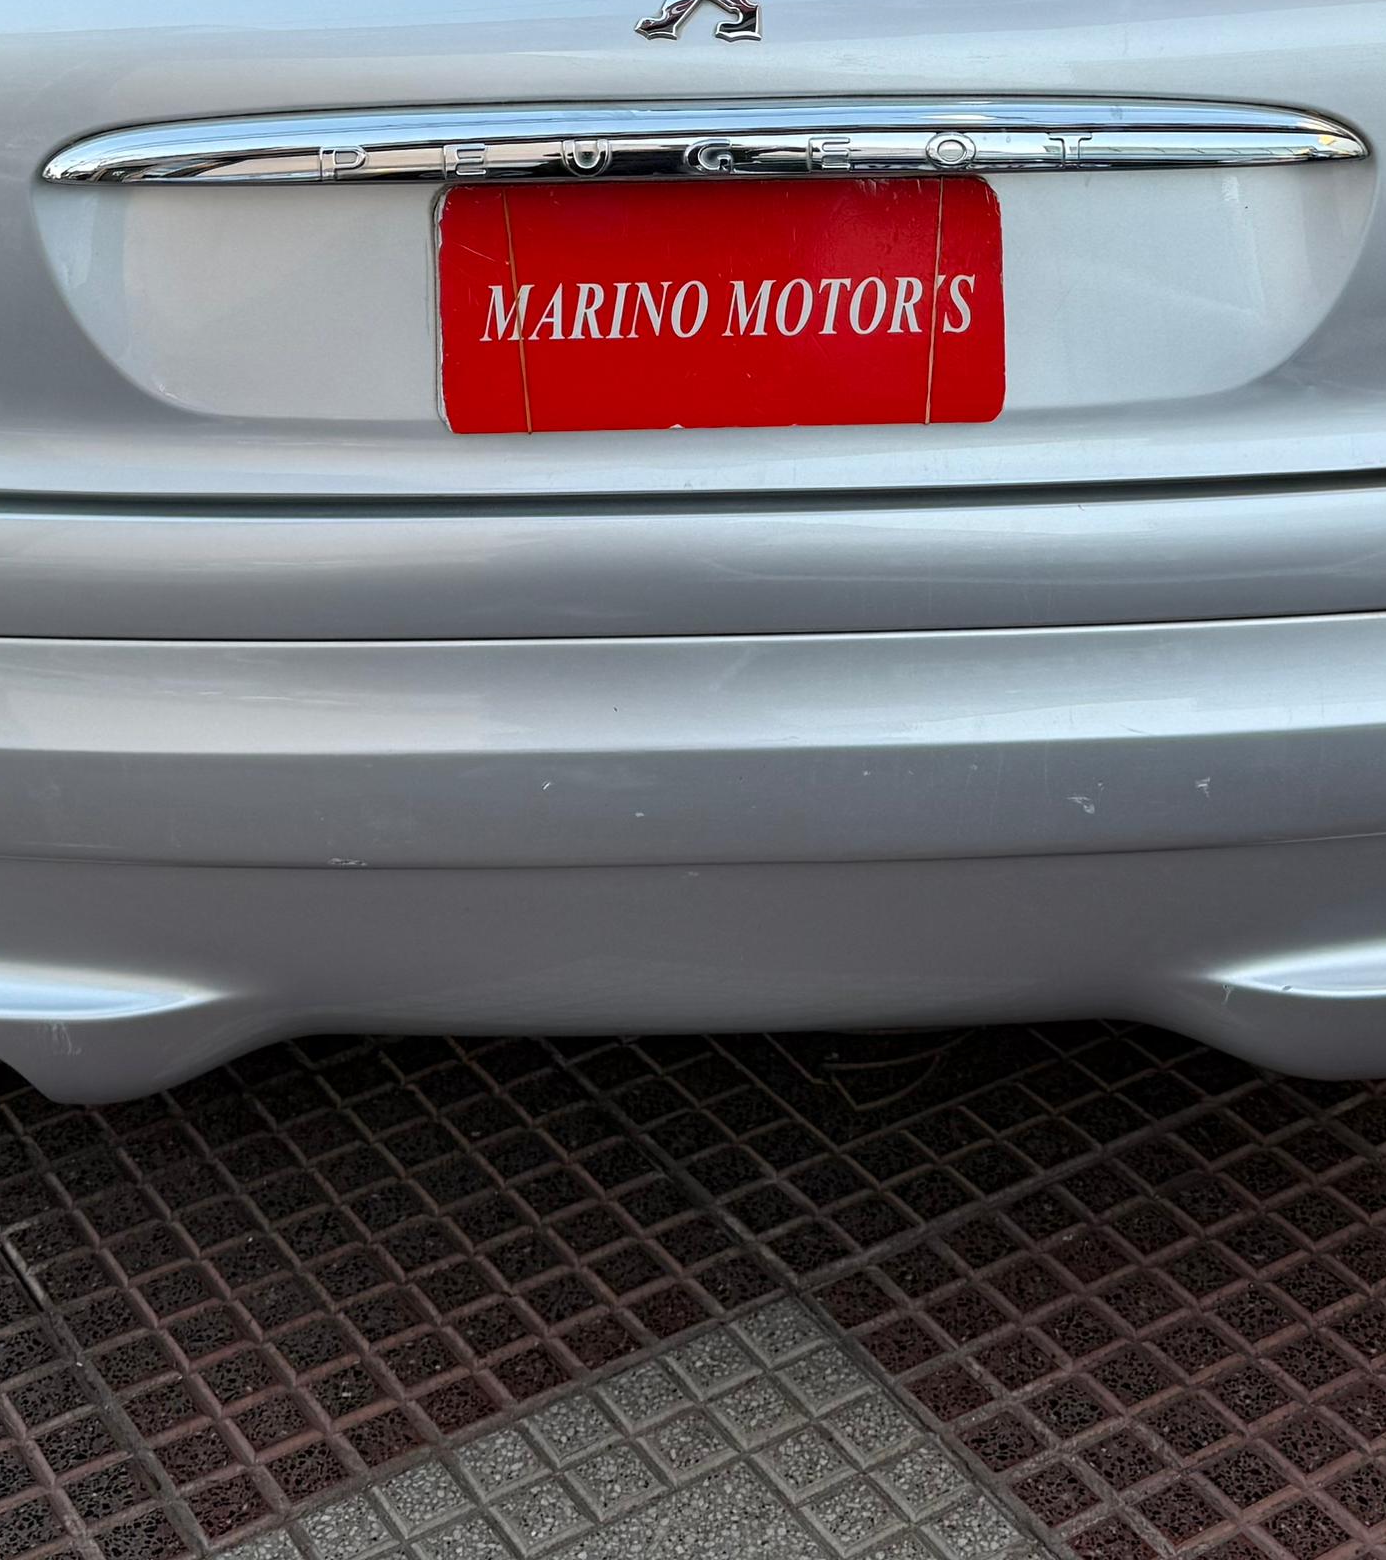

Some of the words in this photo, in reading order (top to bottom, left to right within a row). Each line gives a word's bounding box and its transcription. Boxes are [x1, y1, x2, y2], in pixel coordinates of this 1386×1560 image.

[319, 131, 1094, 180] PEUGEOT
[479, 279, 709, 343] MARINO
[721, 273, 977, 338] MOTOR'S
